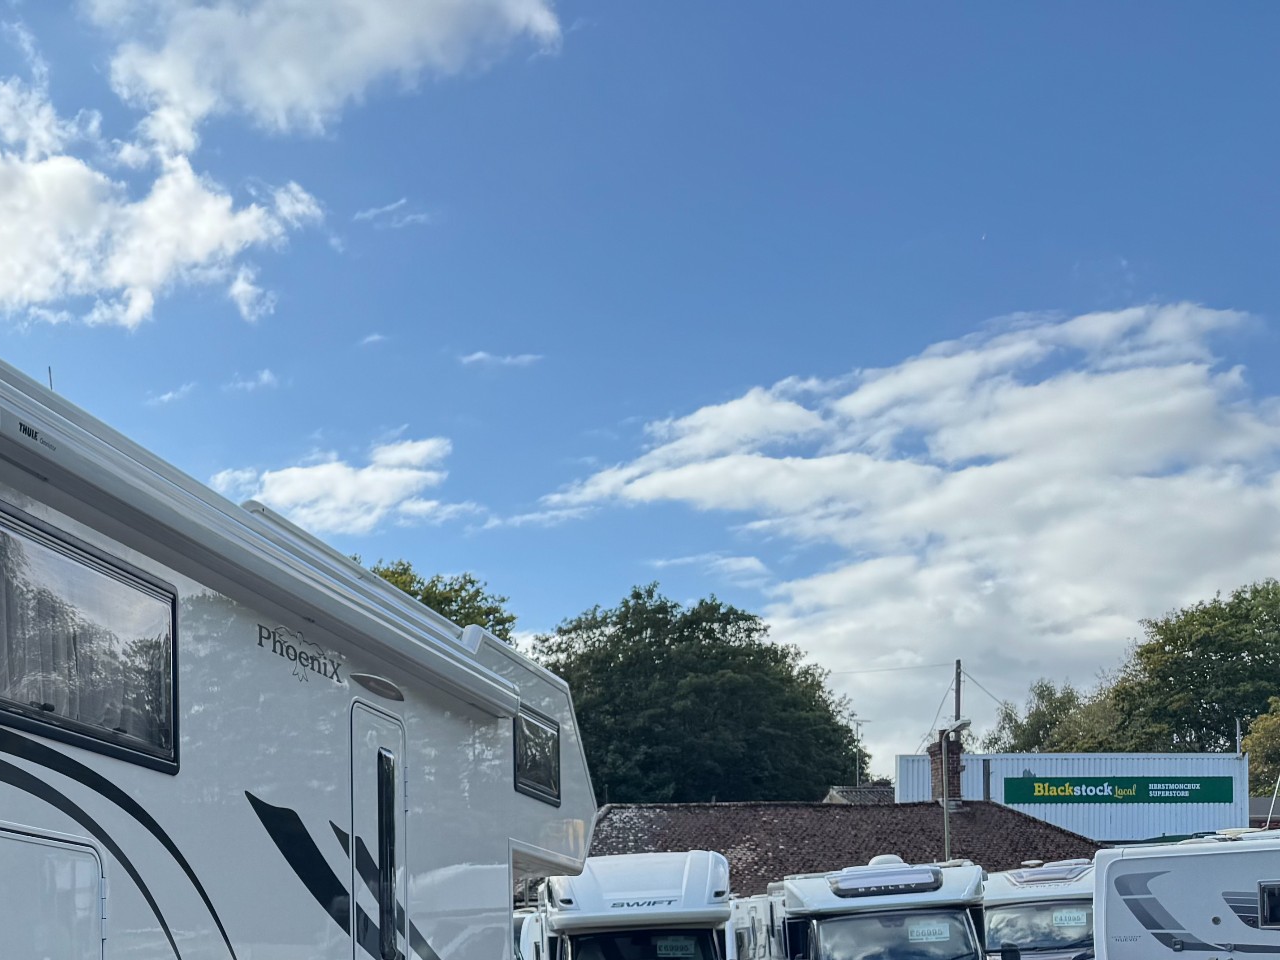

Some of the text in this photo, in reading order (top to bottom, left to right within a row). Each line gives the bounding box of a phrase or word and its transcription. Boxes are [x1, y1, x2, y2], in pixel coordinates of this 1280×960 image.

[19, 422, 39, 441] THULE
[1033, 782, 1137, 799] Blackstock Local
[610, 899, 678, 909] SWIFT
